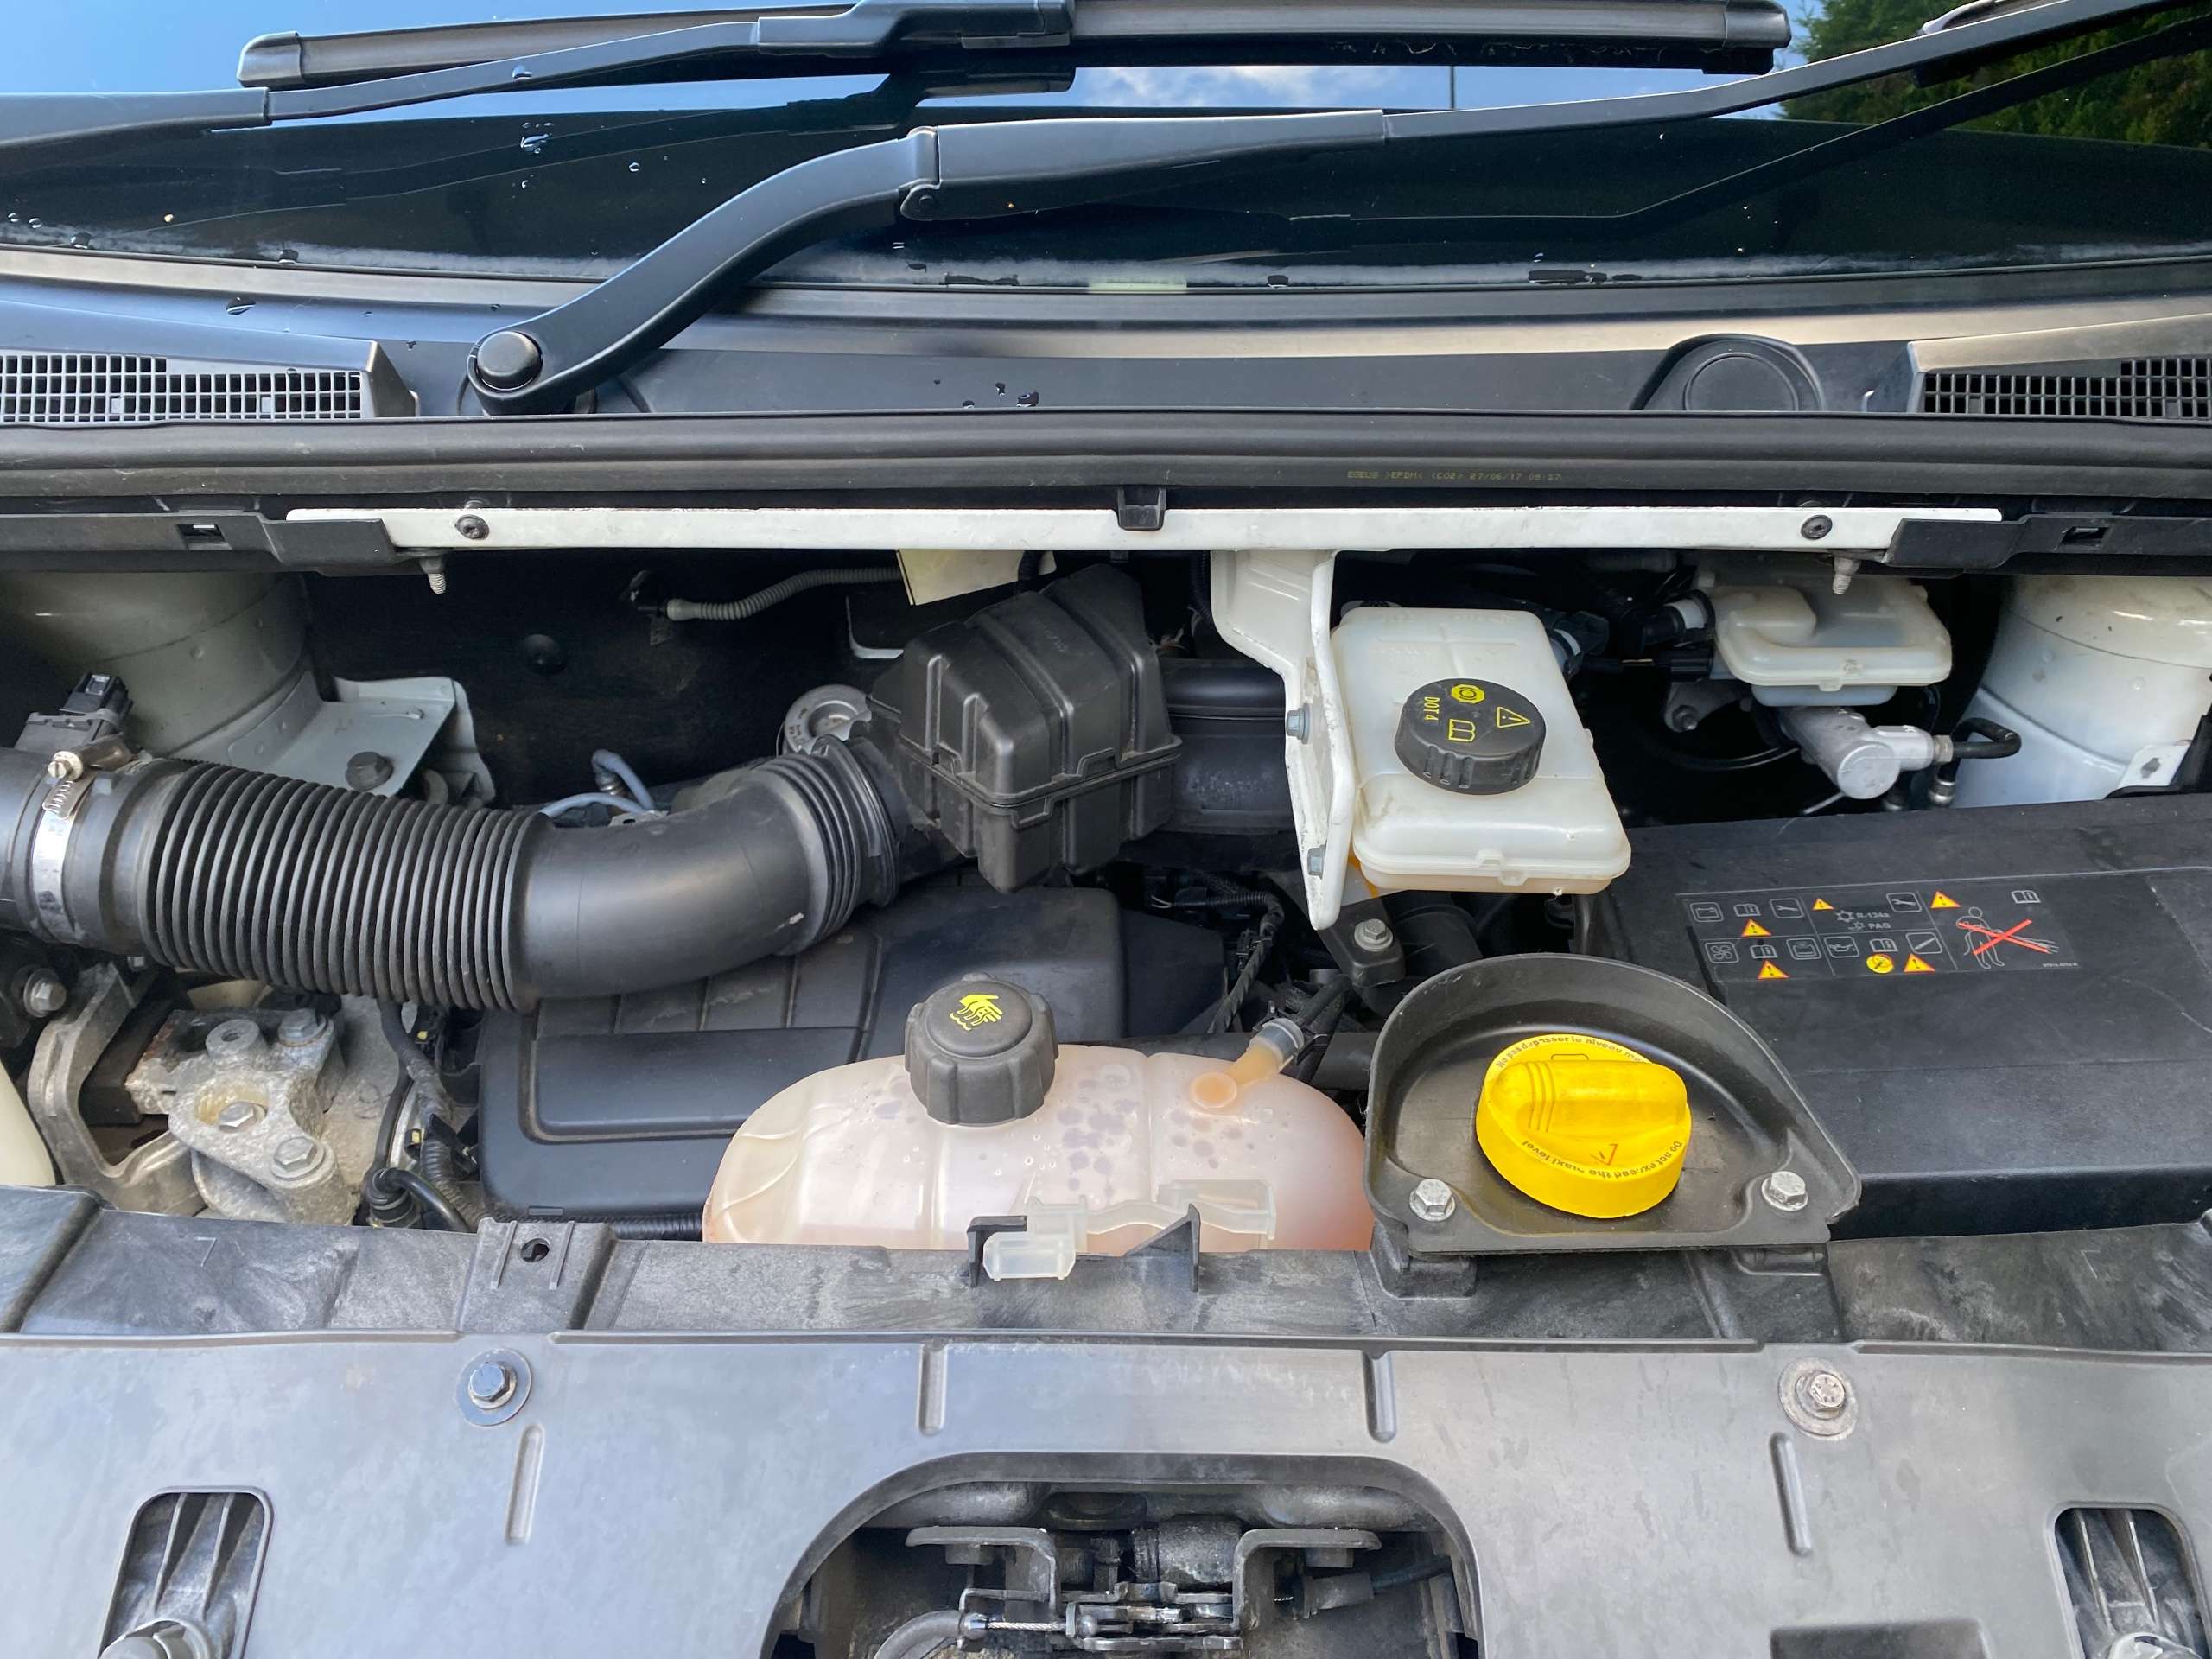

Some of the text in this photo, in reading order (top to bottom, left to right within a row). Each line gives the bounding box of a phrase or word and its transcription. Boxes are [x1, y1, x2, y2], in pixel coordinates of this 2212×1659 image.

[1586, 1039, 1623, 1053] niveau
[1522, 1140, 1551, 1161] level
[1669, 1140, 1682, 1153] Do
[1658, 1150, 1673, 1166] not
[1588, 1169, 1611, 1179] the
